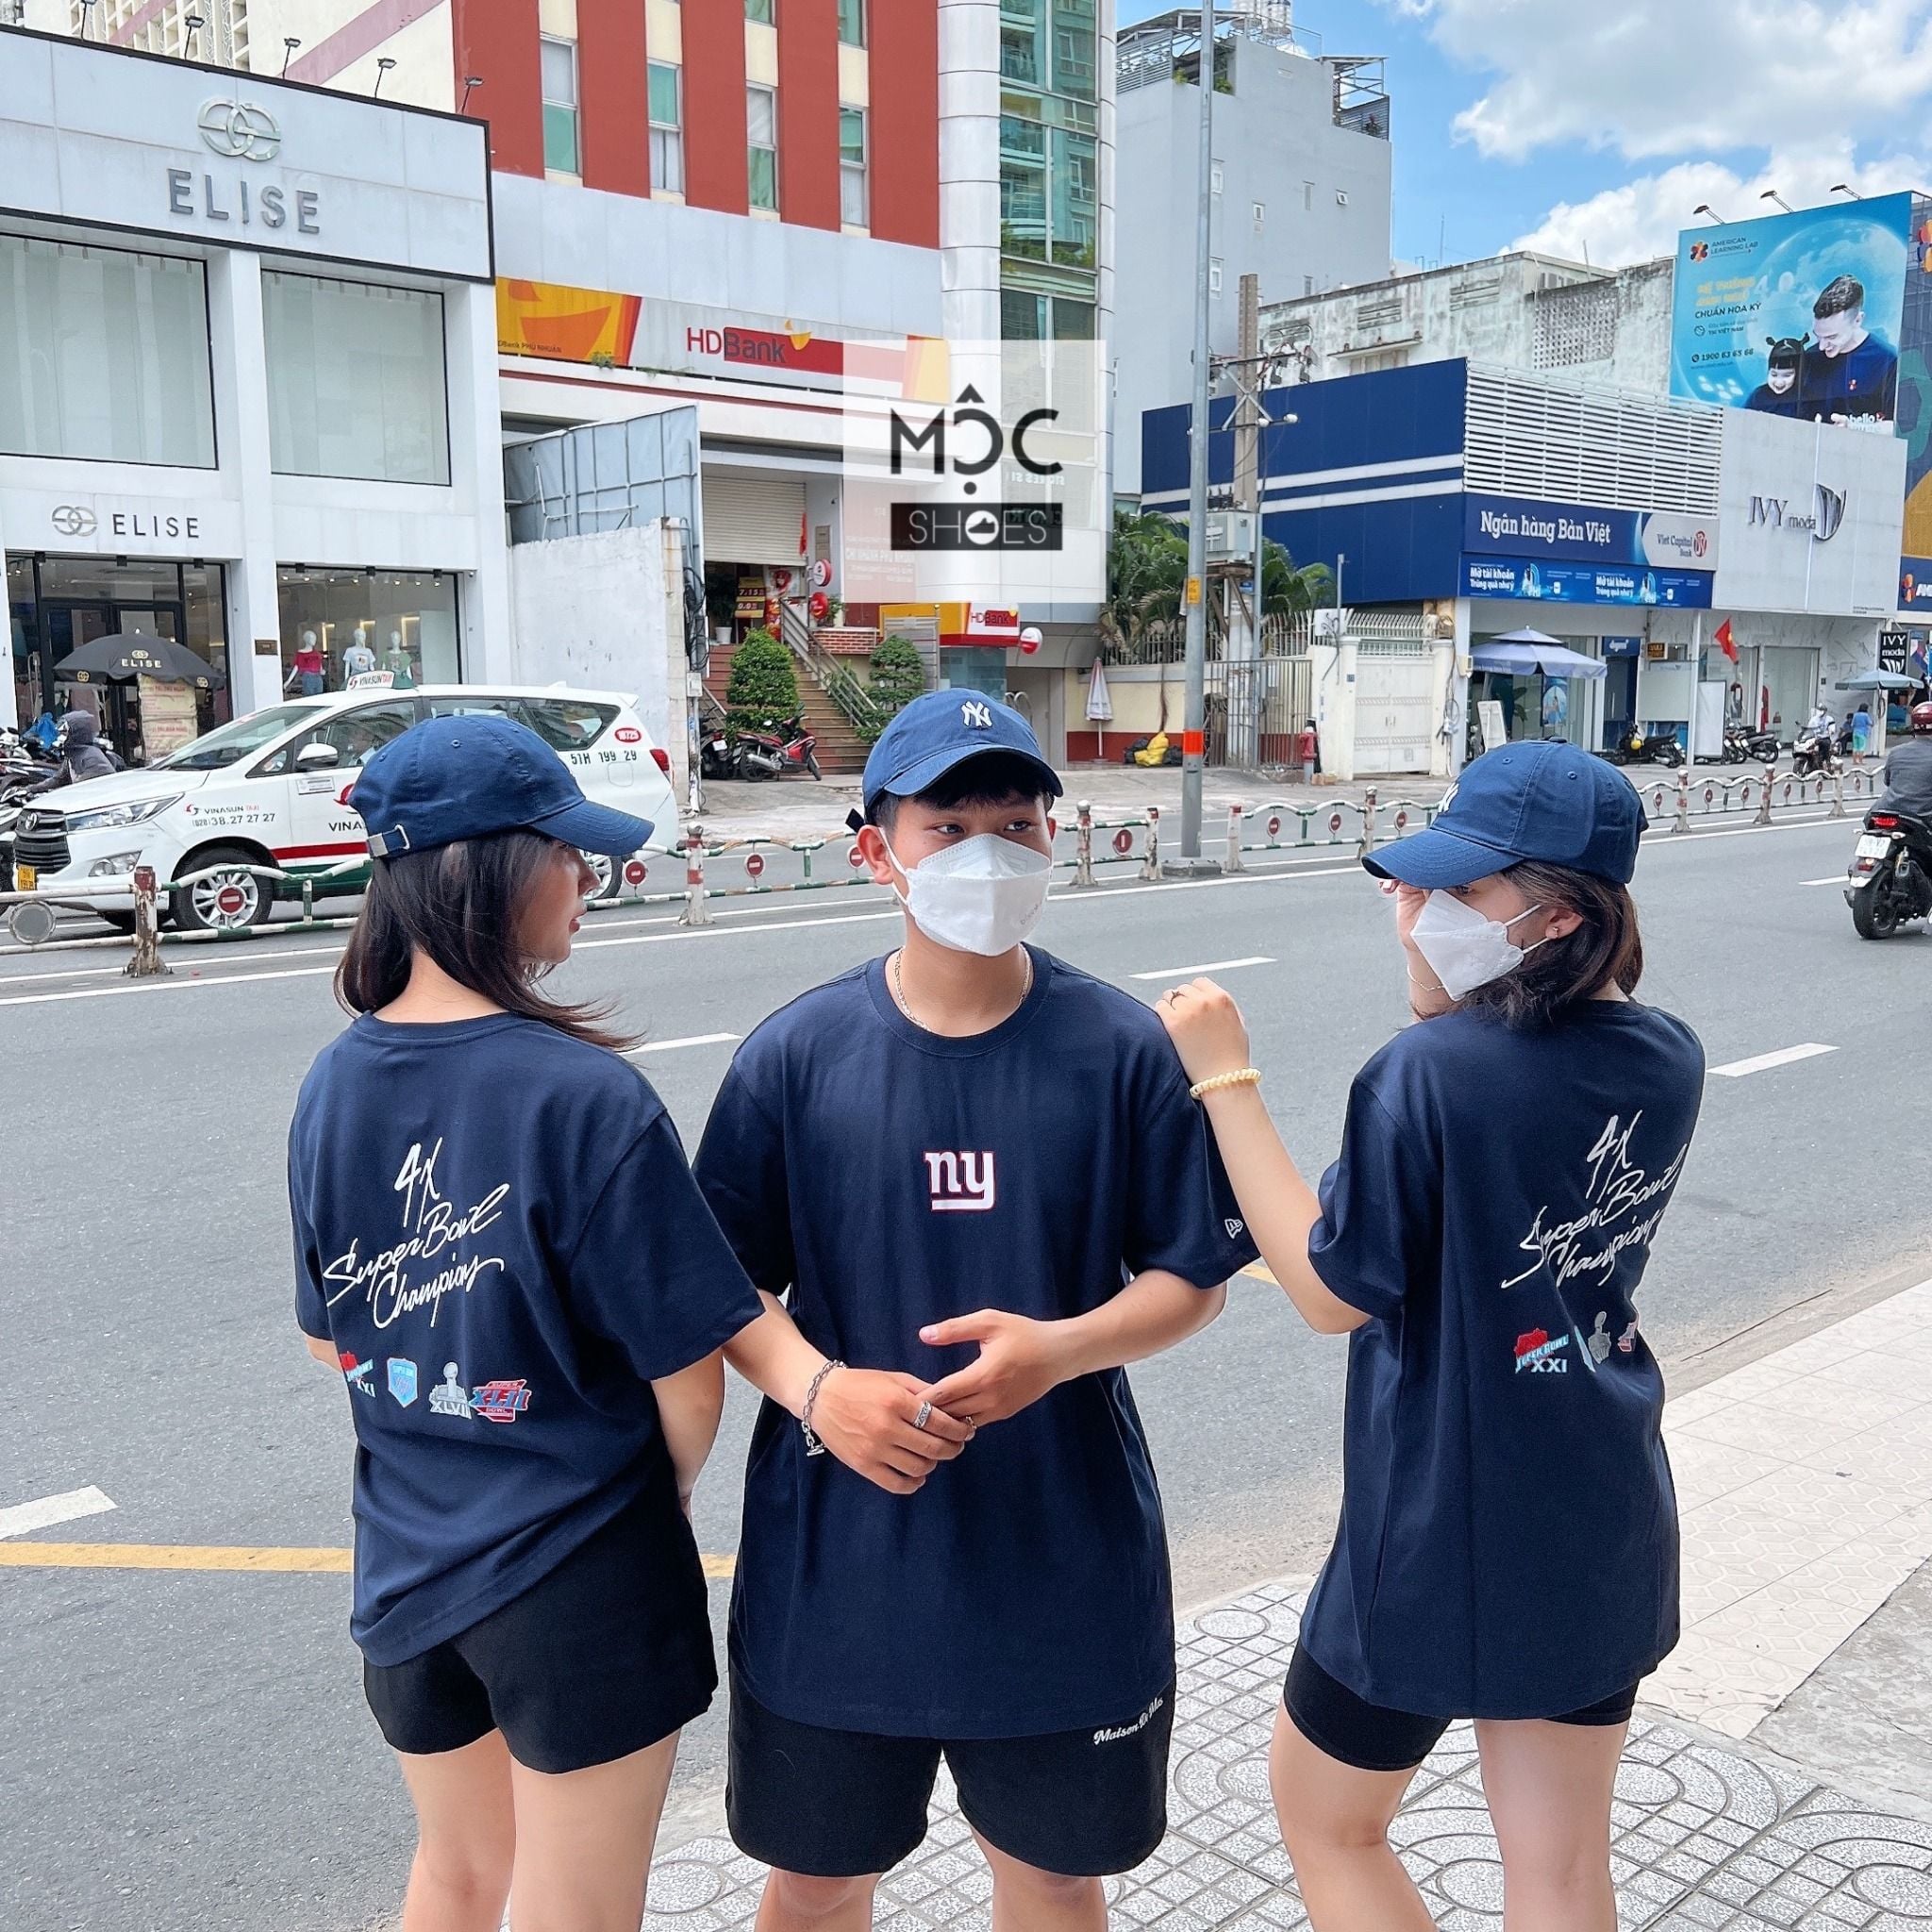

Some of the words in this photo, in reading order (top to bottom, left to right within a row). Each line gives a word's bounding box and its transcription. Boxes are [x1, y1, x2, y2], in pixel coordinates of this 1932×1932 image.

[168, 168, 320, 234] ELISE
[1710, 244, 1744, 255] LEARNING
[1745, 242, 1758, 250] LAB
[1711, 237, 1746, 247] AMERICAN
[686, 326, 786, 364] HDBank
[1748, 495, 1789, 527] IVY
[1789, 514, 1817, 530] moda
[112, 513, 200, 539] ELISE
[1480, 510, 1519, 540] Ngân
[1520, 516, 1556, 544] hàng
[1585, 521, 1611, 547] Việt
[971, 611, 1009, 625] HDBank
[1882, 635, 1906, 646] IVY
[1881, 648, 1906, 657] moda
[121, 658, 162, 668] ELISE
[960, 700, 993, 727] NY
[570, 753, 591, 765] 51H
[598, 750, 617, 762] 199
[624, 750, 638, 761] 29
[204, 806, 244, 815] VINASUN
[246, 813, 259, 824] 27
[262, 812, 275, 823] 27
[328, 821, 367, 832] VINA
[1530, 1358, 1568, 1374] XXI
